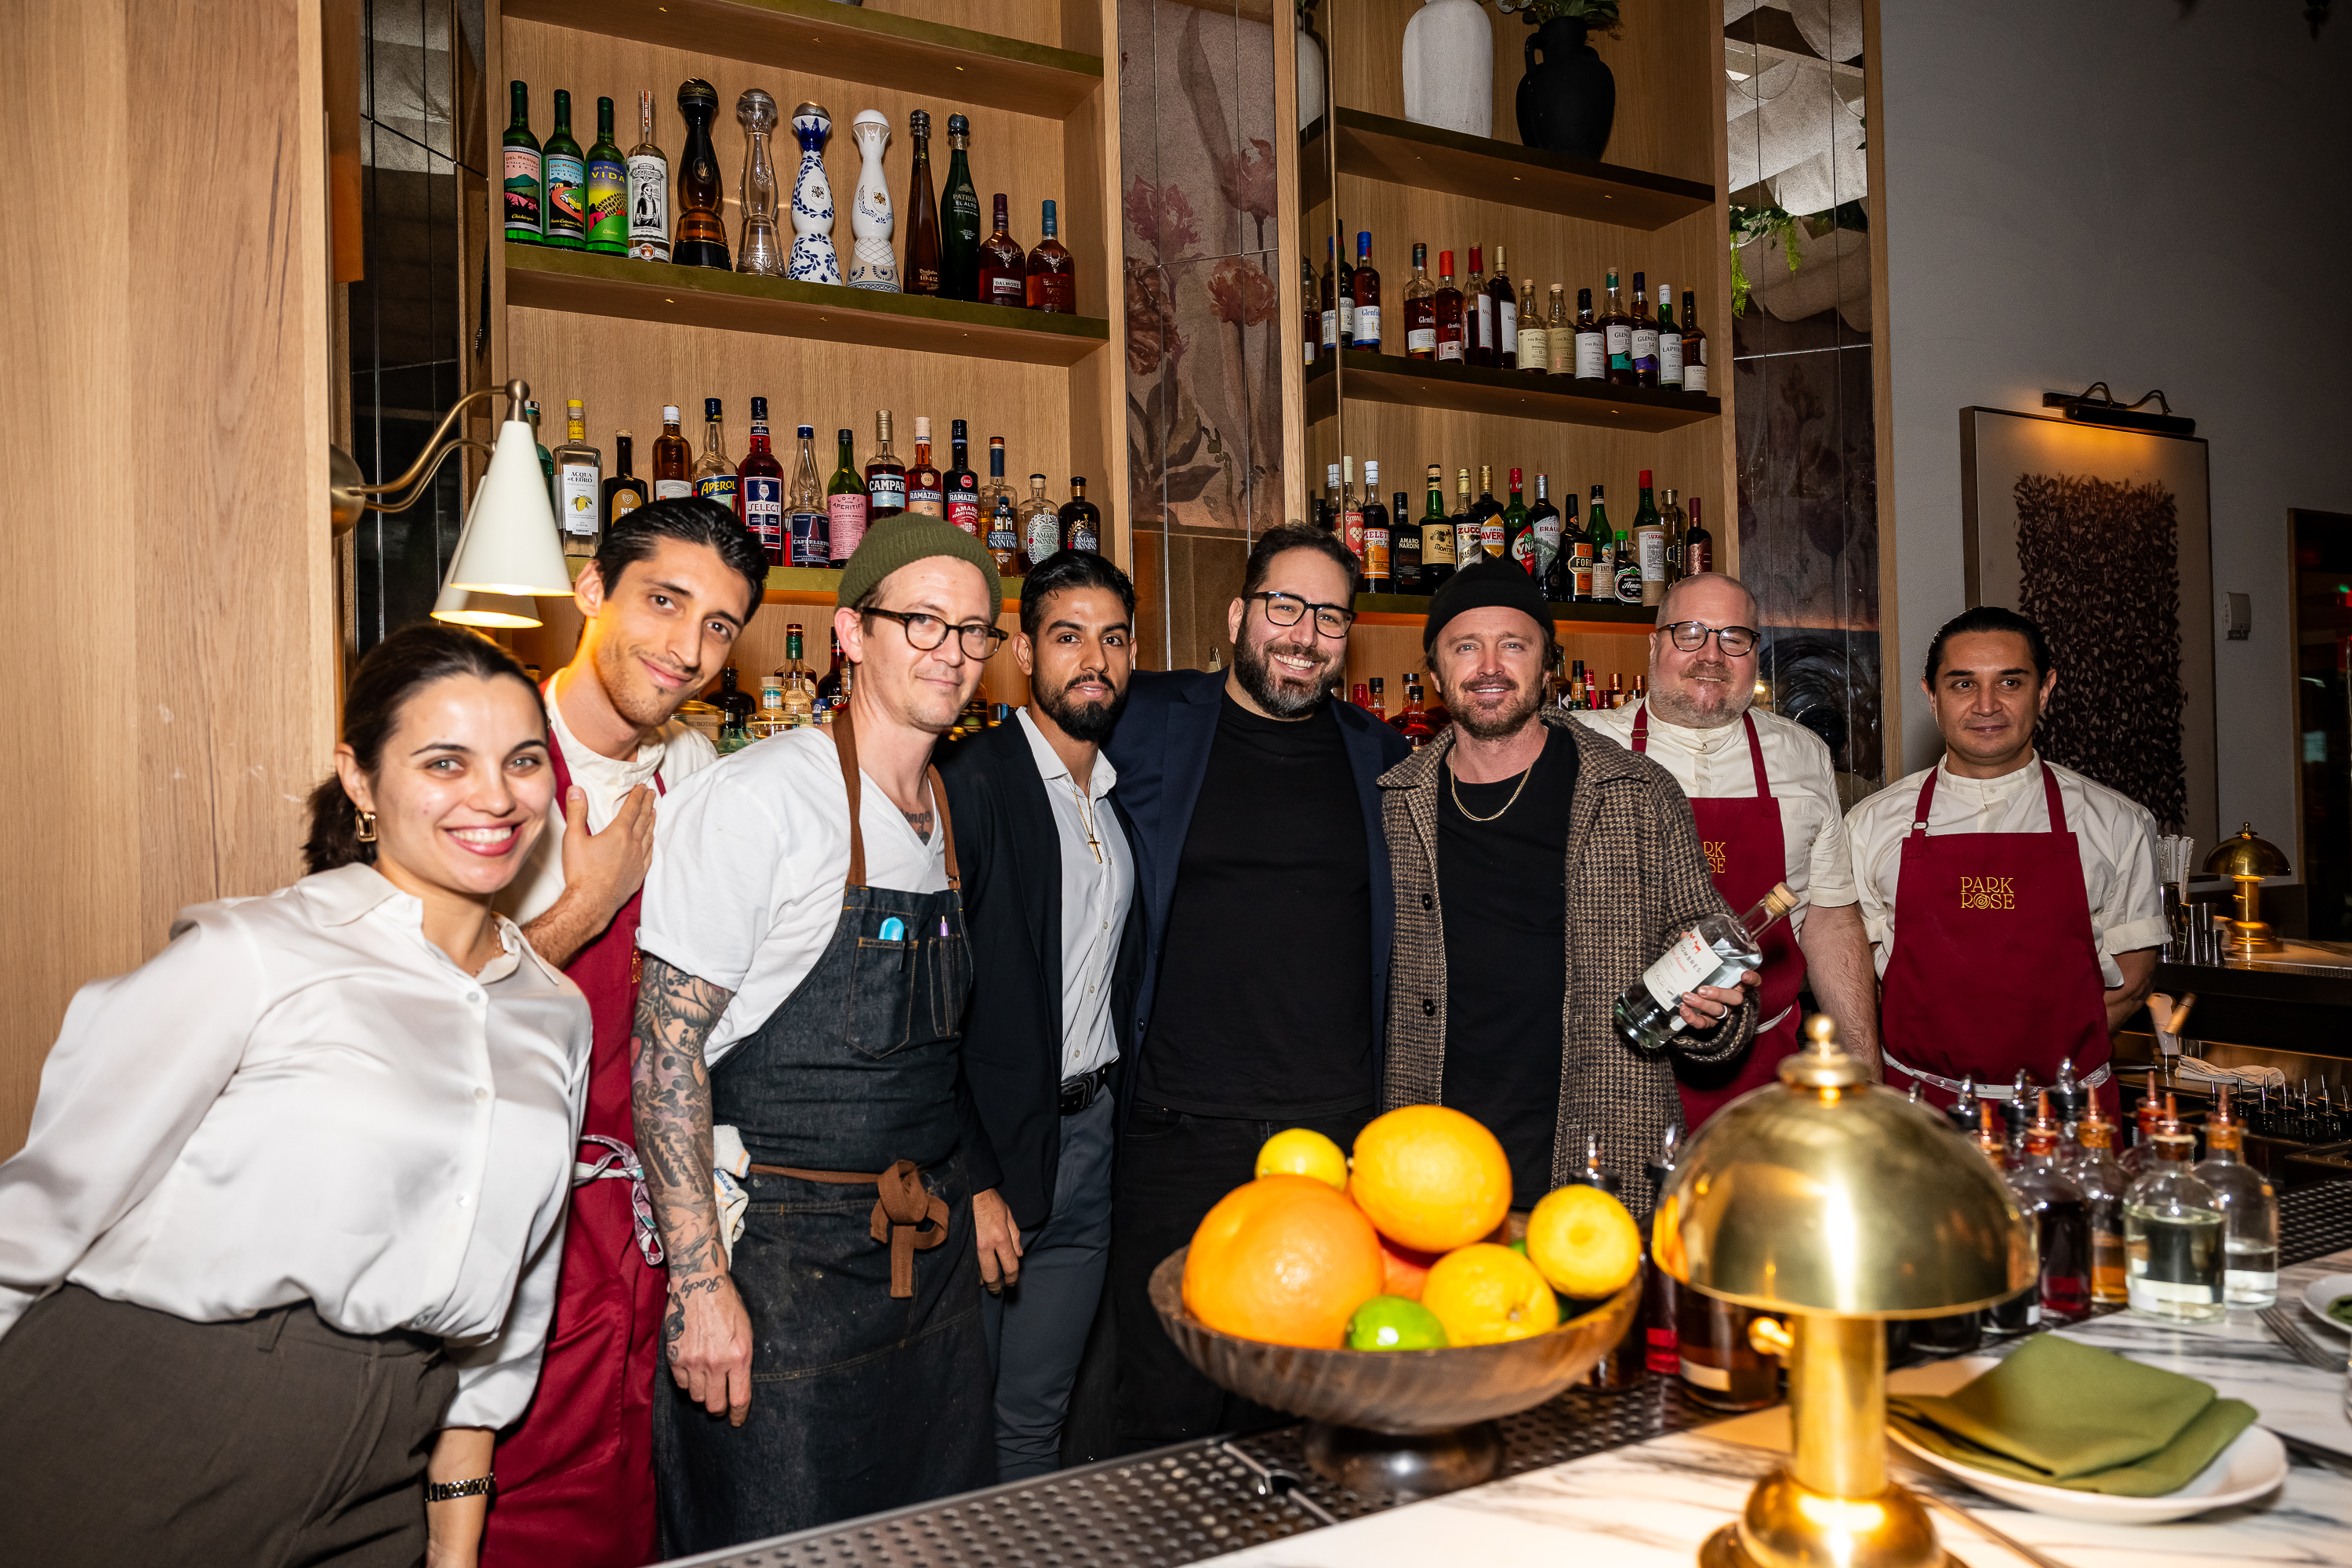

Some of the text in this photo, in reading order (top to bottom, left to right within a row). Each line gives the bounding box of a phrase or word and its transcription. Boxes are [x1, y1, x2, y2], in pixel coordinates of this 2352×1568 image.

[591, 171, 626, 183] VIDA
[953, 194, 977, 203] PATRÓN
[701, 480, 736, 496] APEROL
[747, 503, 780, 514] SELECT
[832, 502, 865, 510] APERITIFS
[955, 505, 978, 514] AMARO
[989, 539, 1018, 549] NONINO
[1576, 557, 1592, 567] FORO
[1960, 877, 2014, 894] PARK
[1960, 892, 2015, 909] ROSE
[680, 1275, 727, 1299] Rocky
